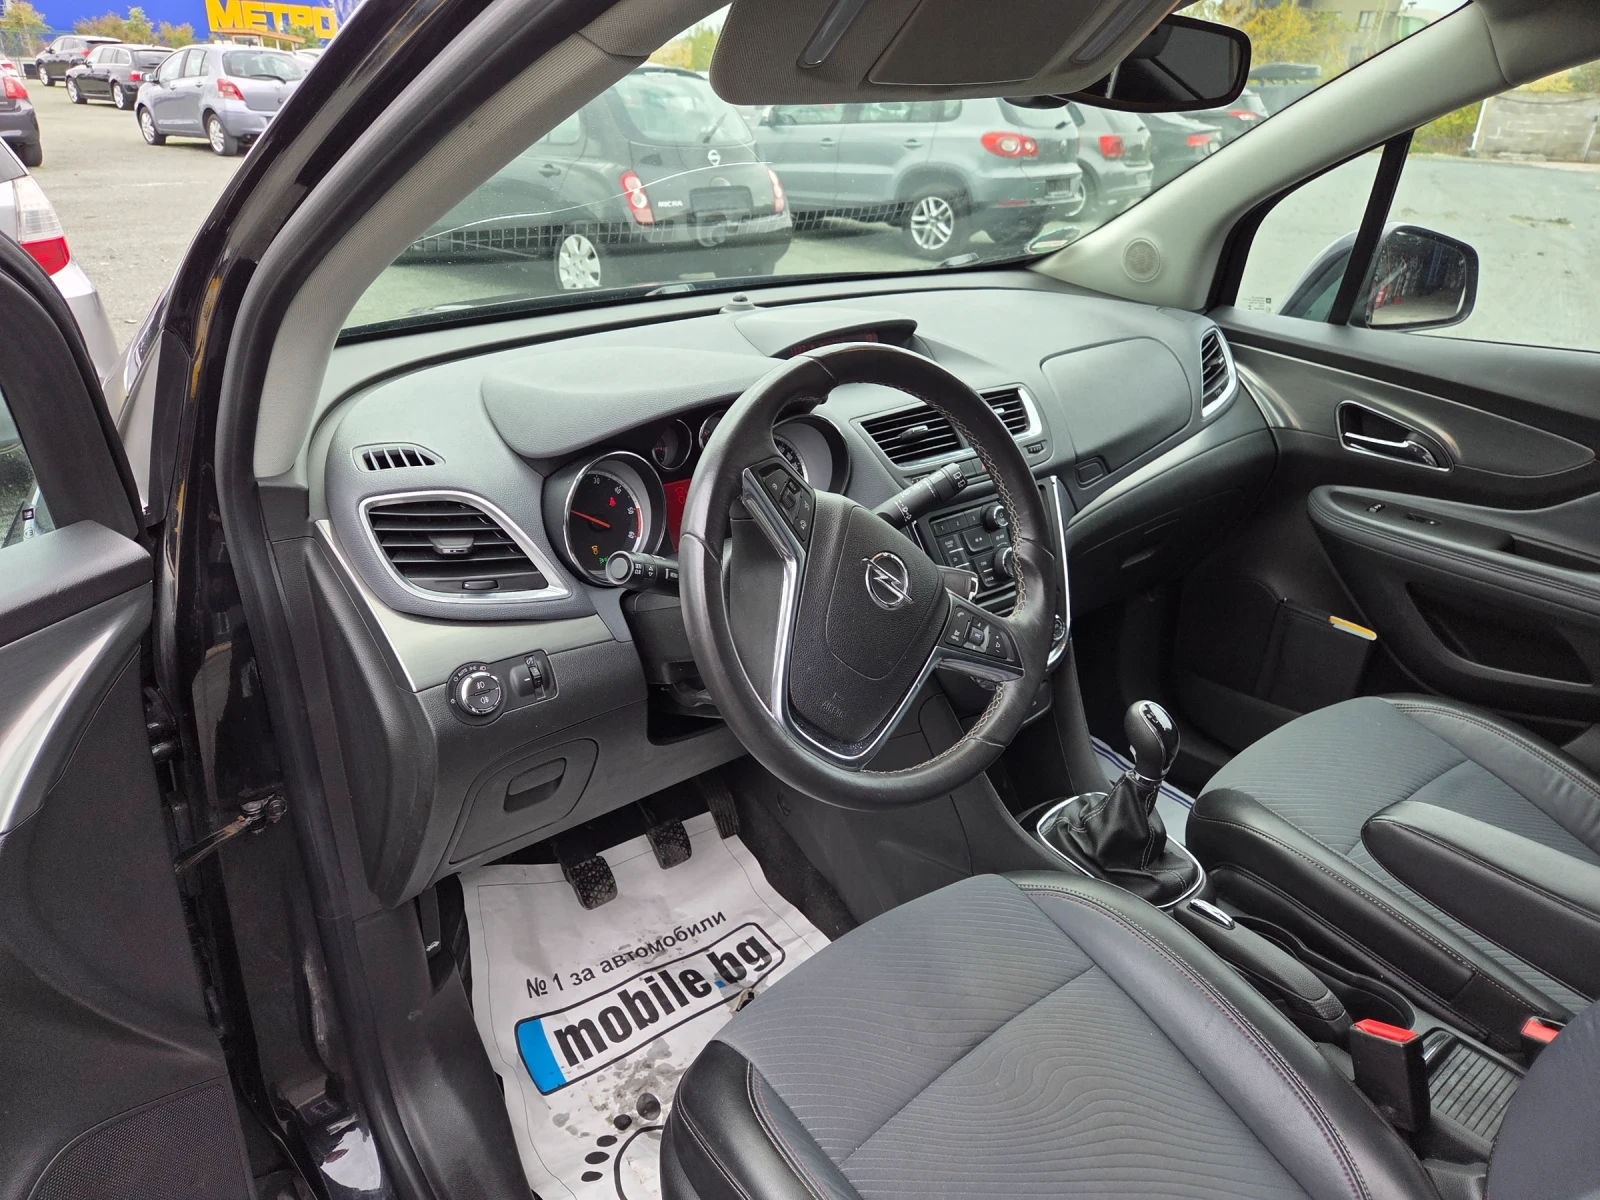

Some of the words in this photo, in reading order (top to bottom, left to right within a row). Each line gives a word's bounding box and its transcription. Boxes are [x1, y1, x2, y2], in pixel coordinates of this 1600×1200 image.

[205, 0, 339, 39] METRO
[657, 200, 683, 208] MICRA
[593, 476, 601, 485] 30
[627, 506, 635, 515] 50
[552, 973, 564, 991] 1
[569, 967, 596, 986] за
[599, 911, 726, 974] автомобили
[553, 935, 773, 1068] mobile.bg
